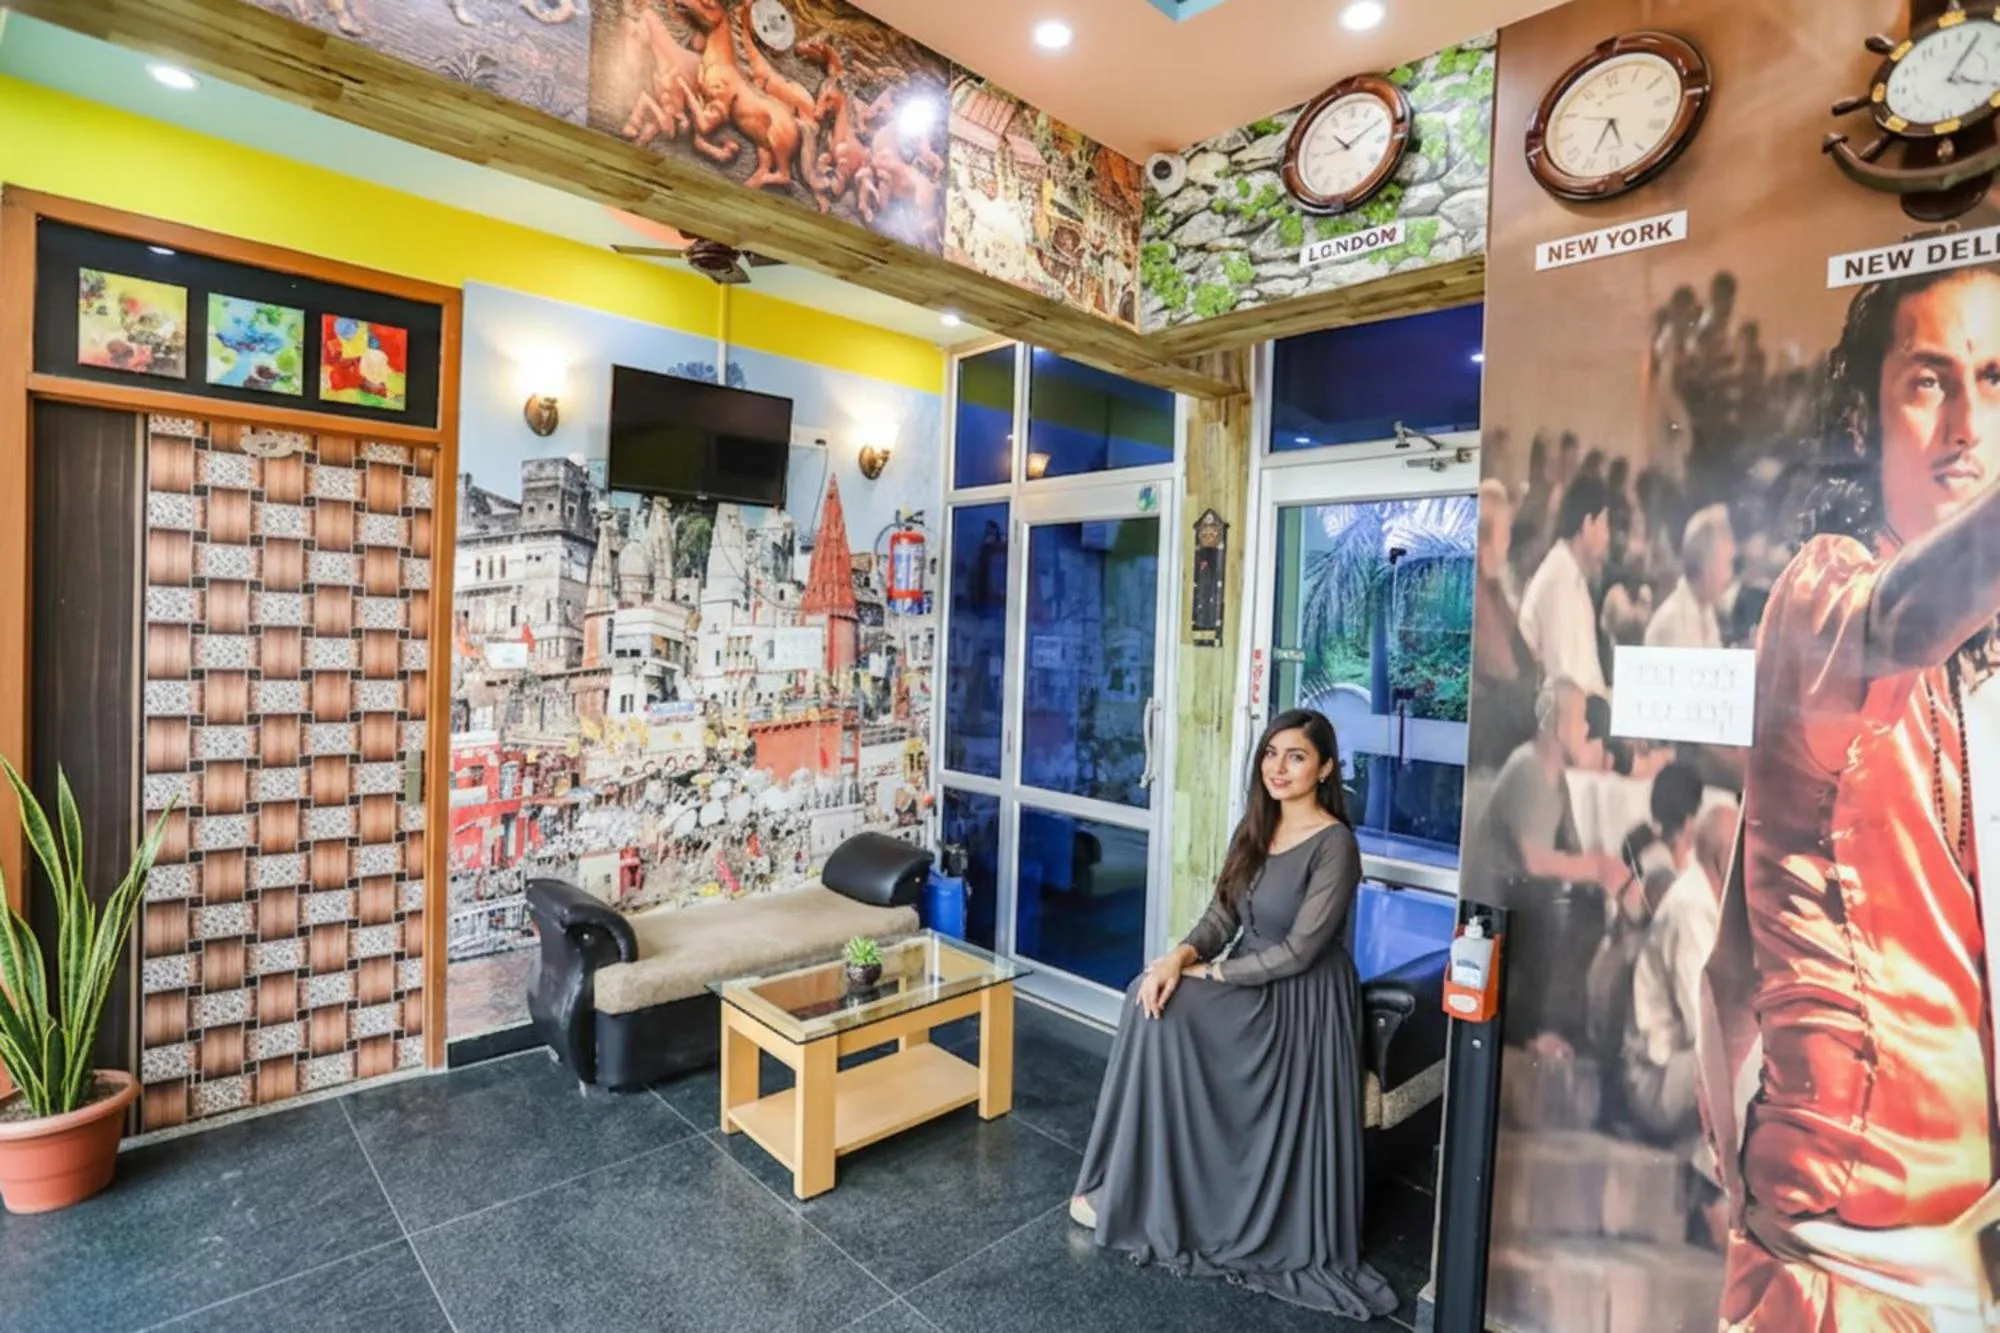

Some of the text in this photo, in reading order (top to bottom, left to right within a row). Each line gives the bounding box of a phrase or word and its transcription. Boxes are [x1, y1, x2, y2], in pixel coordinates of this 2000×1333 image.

[1308, 226, 1397, 261] LONDON
[1547, 217, 1674, 262] NEW YORK
[1844, 248, 1914, 278] NEW
